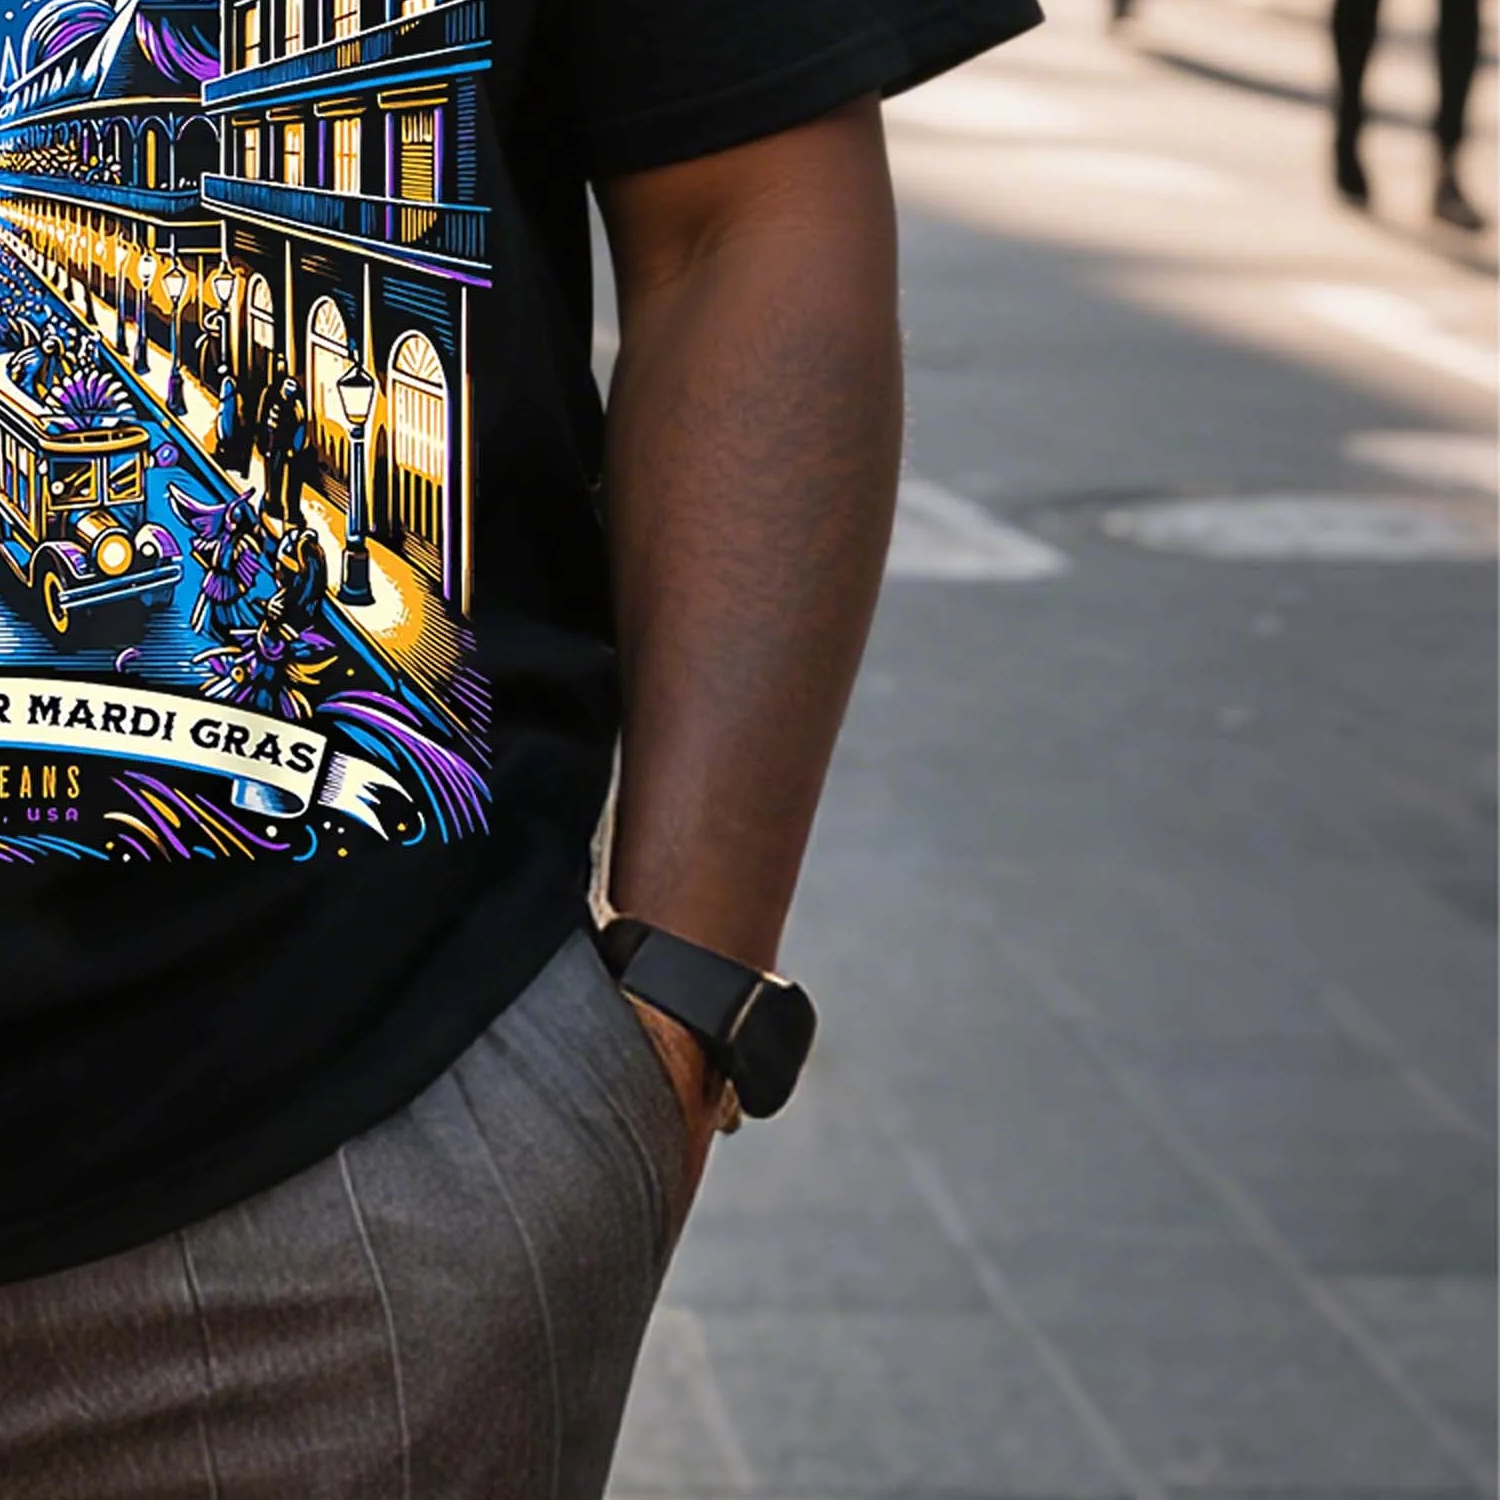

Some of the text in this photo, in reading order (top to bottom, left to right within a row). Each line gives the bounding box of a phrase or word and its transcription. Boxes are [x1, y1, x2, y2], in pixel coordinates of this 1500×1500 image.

[27, 695, 177, 742] MARDI
[189, 719, 317, 774] GRAS
[26, 807, 79, 822] USA
